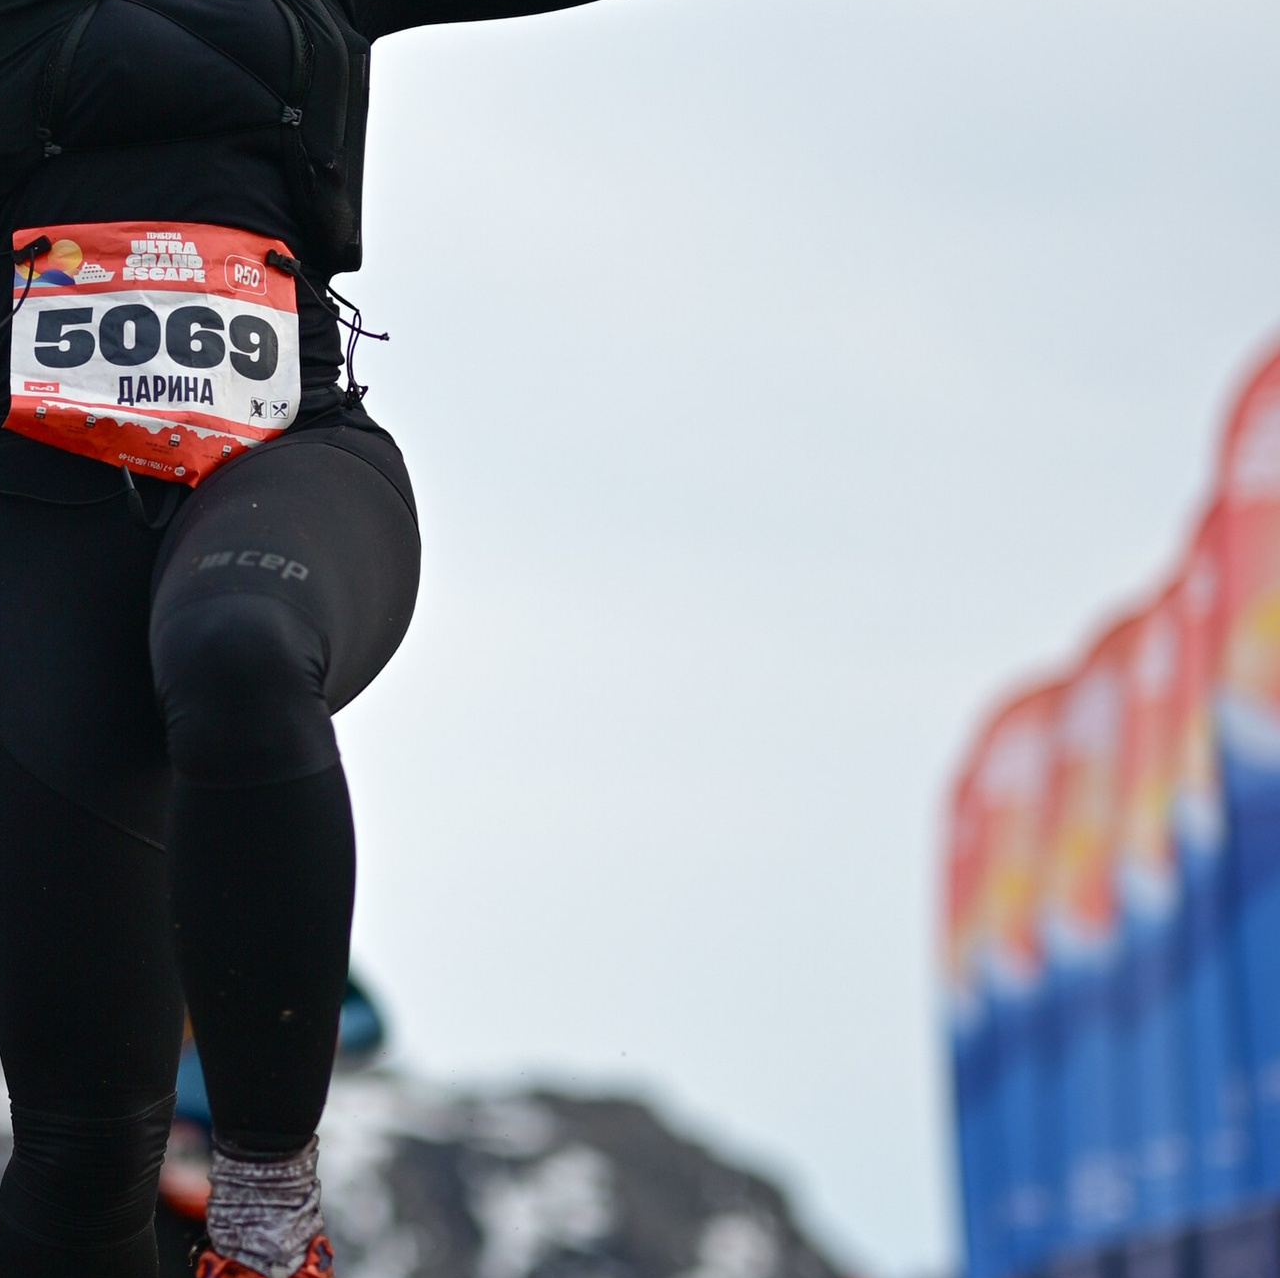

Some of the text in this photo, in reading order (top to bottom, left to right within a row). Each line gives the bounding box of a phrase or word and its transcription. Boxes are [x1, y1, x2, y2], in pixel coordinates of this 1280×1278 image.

[146, 232, 182, 240] ТЕРИБЕРКА
[130, 240, 198, 255] ULTRA
[125, 253, 203, 269] GRAND
[122, 267, 206, 283] ESCAPE
[234, 263, 260, 288] R50
[34, 303, 279, 381] 5069
[117, 375, 214, 406] ДАРИНА
